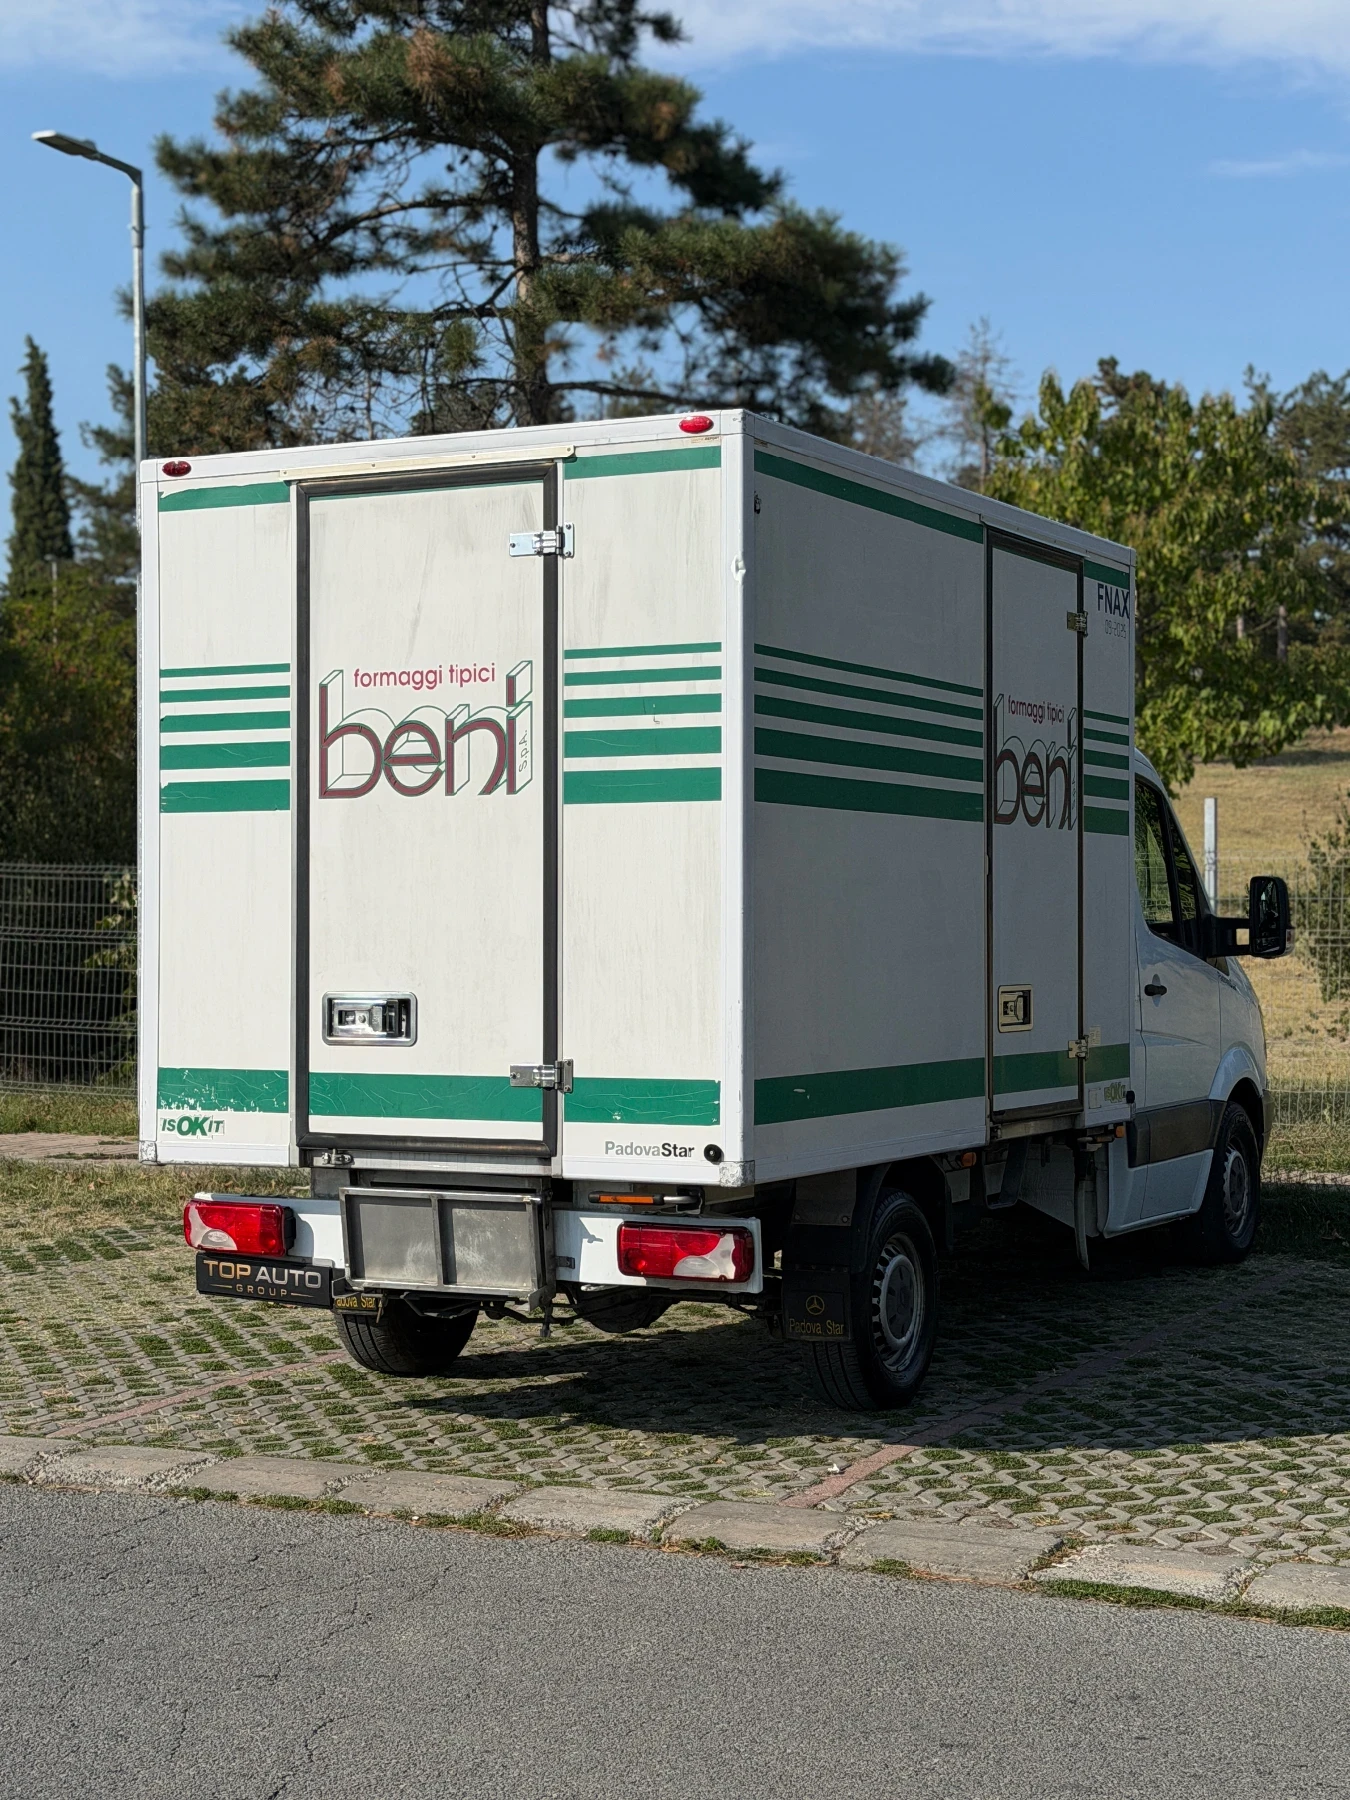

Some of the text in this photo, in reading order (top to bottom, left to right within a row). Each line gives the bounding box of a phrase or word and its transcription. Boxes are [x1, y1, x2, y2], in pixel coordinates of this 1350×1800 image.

[1097, 582, 1130, 619] FNAX
[353, 662, 496, 690] formaggi tipici
[1007, 695, 1065, 725] formaggi tipici
[318, 660, 533, 799] beni
[993, 693, 1077, 831] beni
[203, 1259, 322, 1289] TOP AUTO
[236, 1283, 288, 1298] GROUP
[336, 1296, 358, 1308] adova
[789, 1318, 844, 1335] Padova Star
